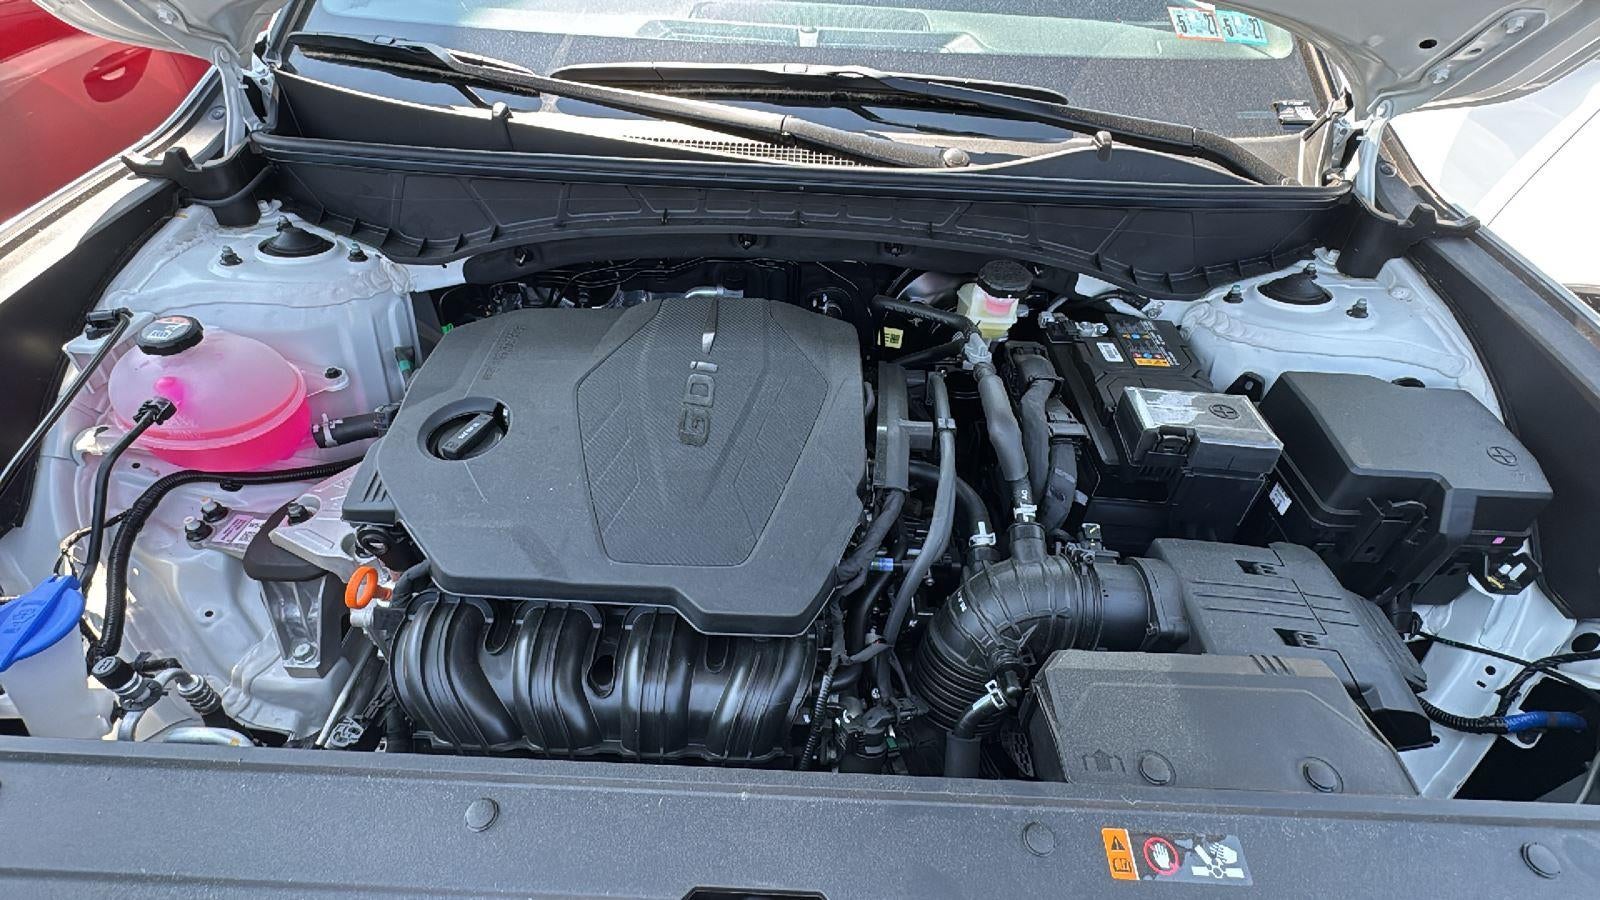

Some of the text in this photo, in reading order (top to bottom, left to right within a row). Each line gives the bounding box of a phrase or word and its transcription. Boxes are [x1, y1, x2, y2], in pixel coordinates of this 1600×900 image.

[1176, 13, 1219, 37] 5 27
[1223, 17, 1264, 39] 5 27
